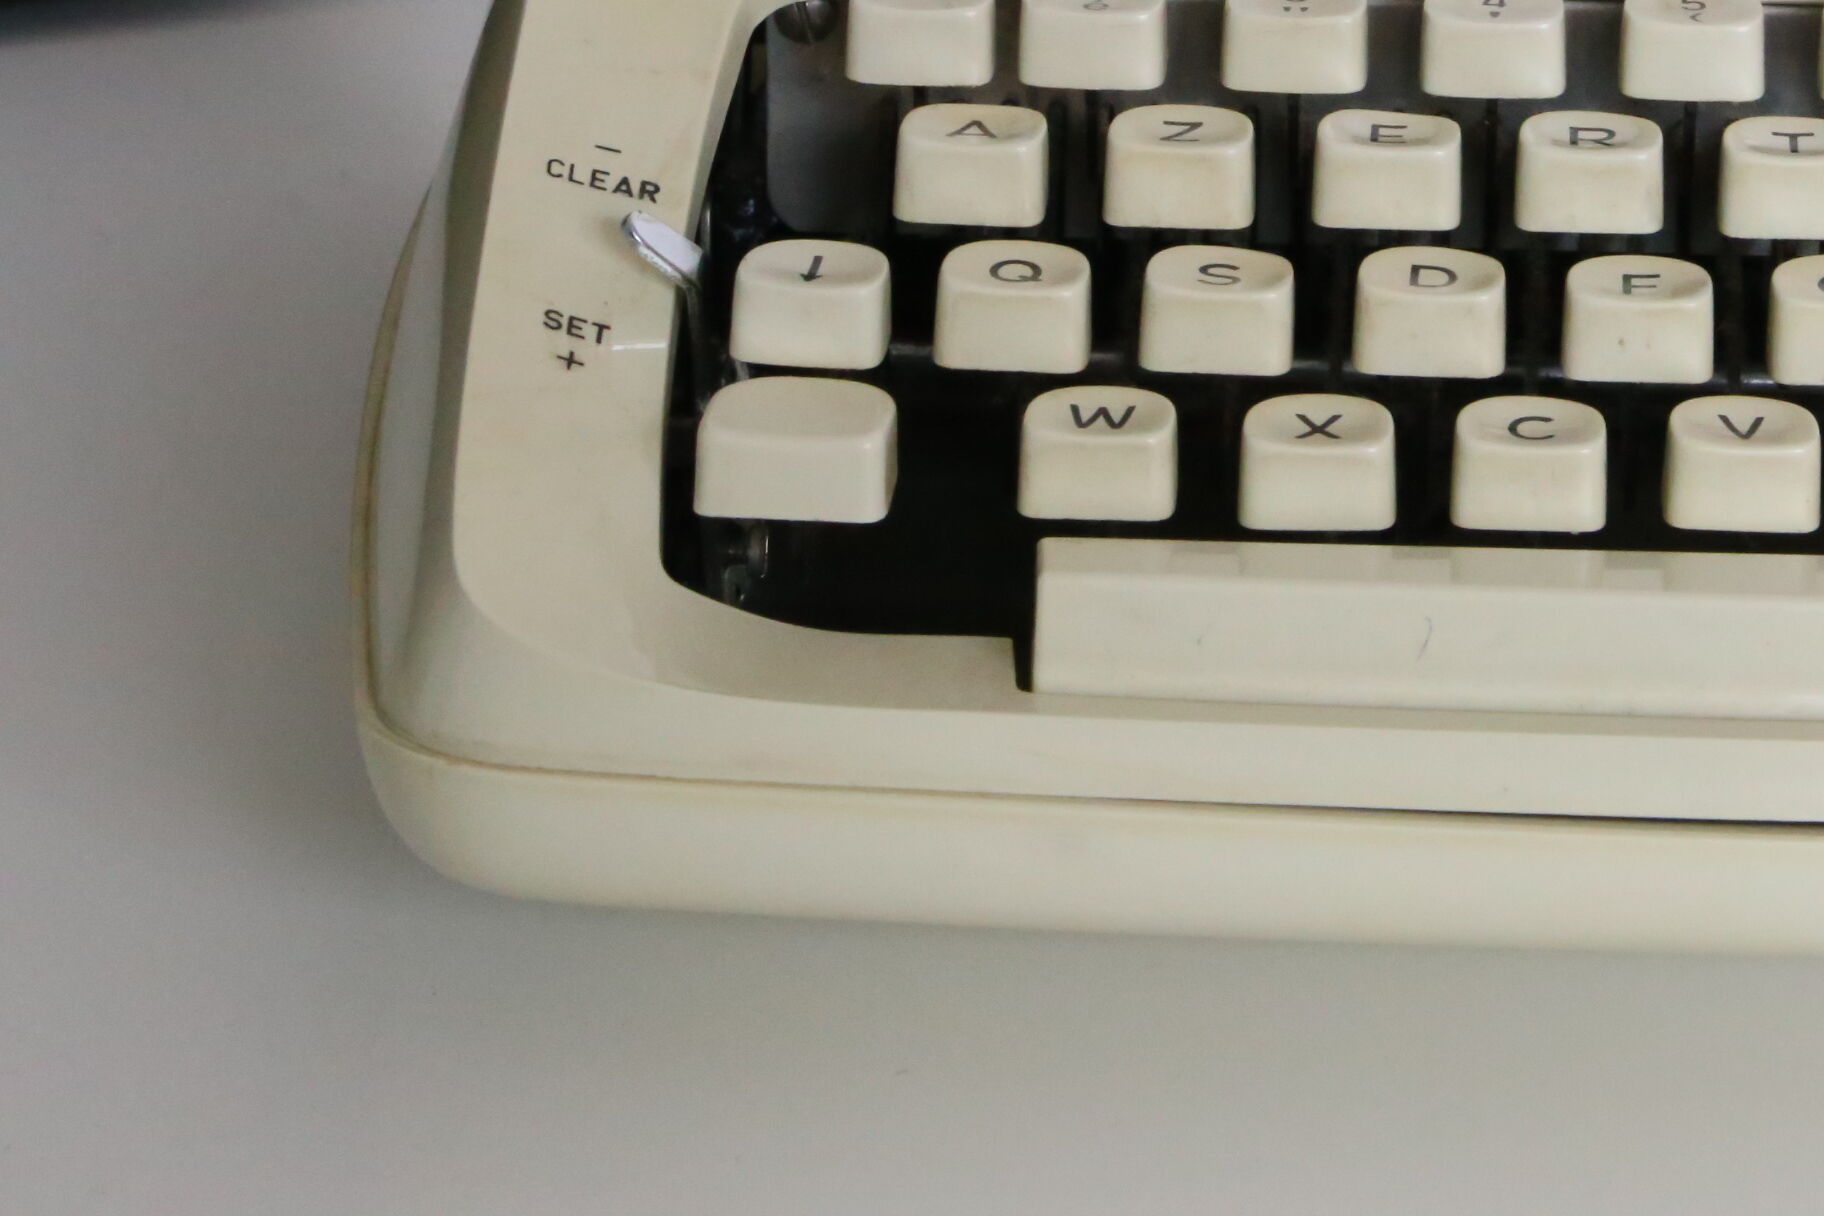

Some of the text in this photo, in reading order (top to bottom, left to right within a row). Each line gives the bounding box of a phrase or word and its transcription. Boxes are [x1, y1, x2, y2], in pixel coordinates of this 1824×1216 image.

[946, 118, 998, 139] A
[1160, 120, 1204, 142] Z
[1369, 124, 1408, 144] E
[1568, 126, 1617, 147] R
[1771, 131, 1816, 154] T
[546, 158, 661, 204] CLEAR
[989, 259, 1043, 283] Q
[1197, 263, 1243, 286] S
[1409, 264, 1459, 288] D
[1621, 273, 1661, 296] F
[543, 309, 612, 345] SET
[1069, 403, 1136, 430] W
[1295, 413, 1342, 440] X
[1507, 416, 1556, 441] C
[1717, 413, 1765, 440] V
